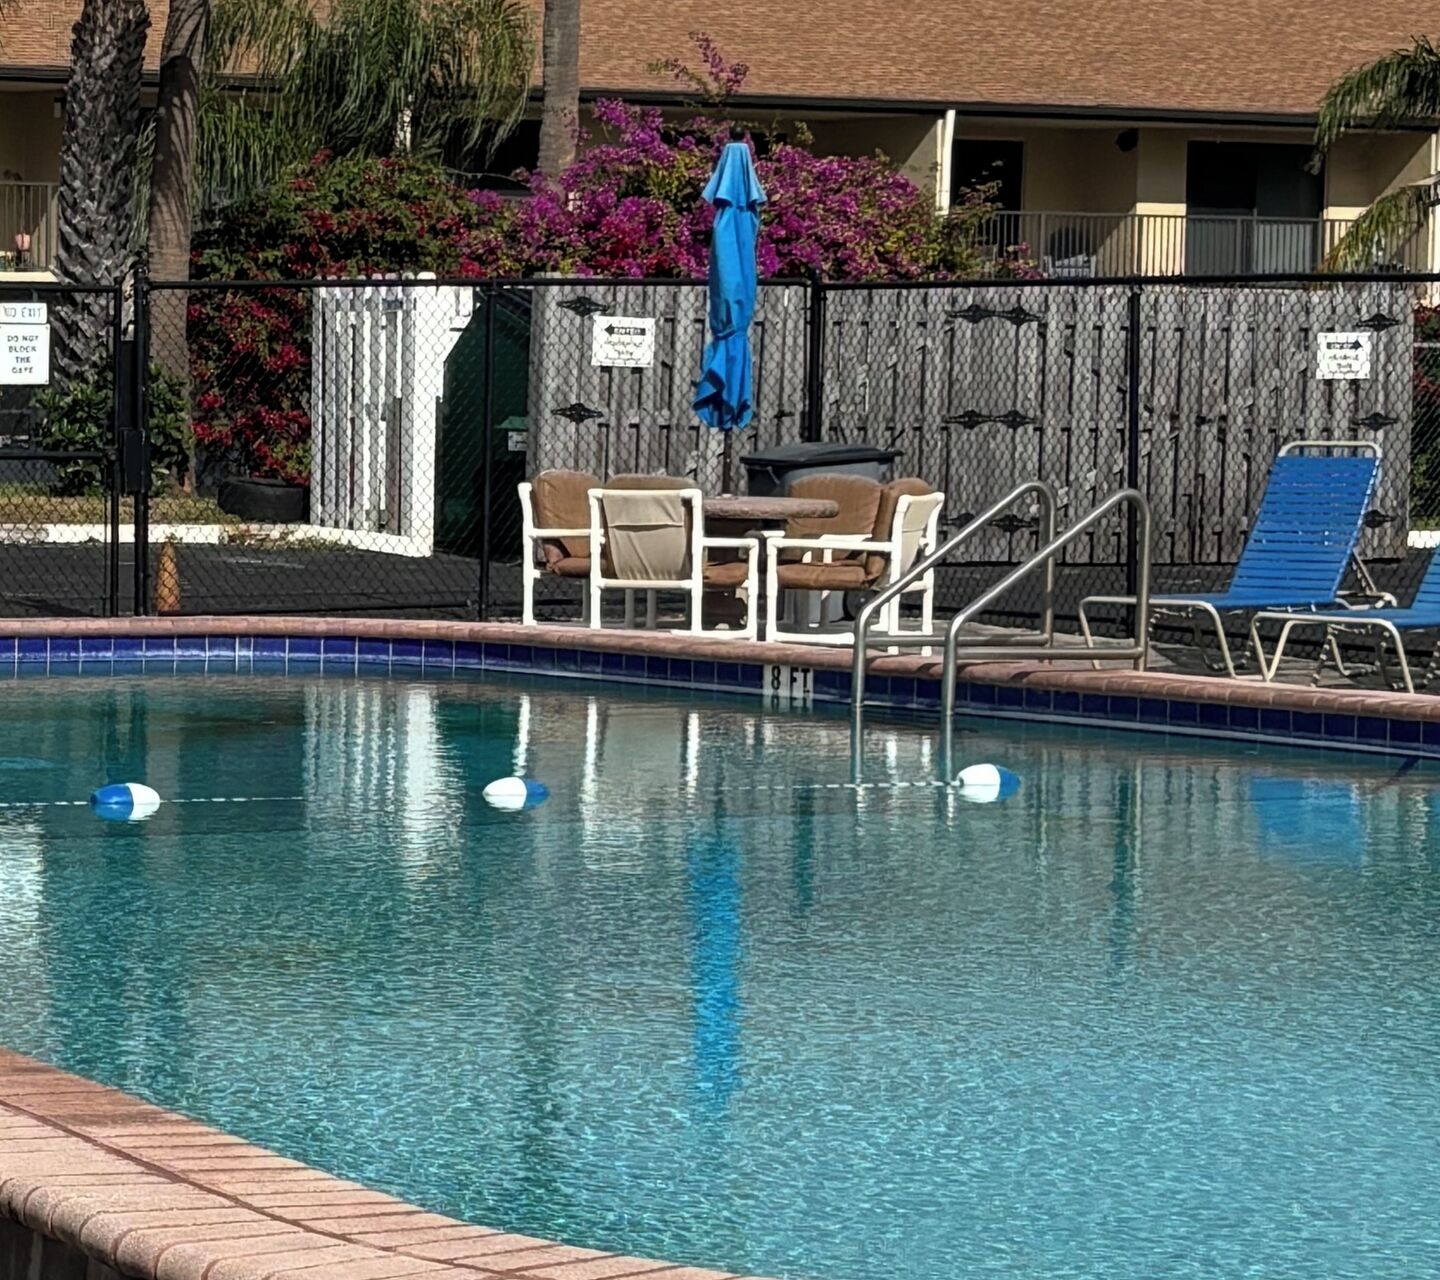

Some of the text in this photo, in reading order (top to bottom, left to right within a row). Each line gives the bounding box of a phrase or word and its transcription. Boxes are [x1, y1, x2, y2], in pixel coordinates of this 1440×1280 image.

[21, 306, 42, 318] EXIT
[7, 335, 39, 343] DO NOT
[8, 345, 37, 353] BLOCK
[15, 356, 31, 364] THE
[11, 366, 34, 374] GATE
[771, 665, 781, 690] 8
